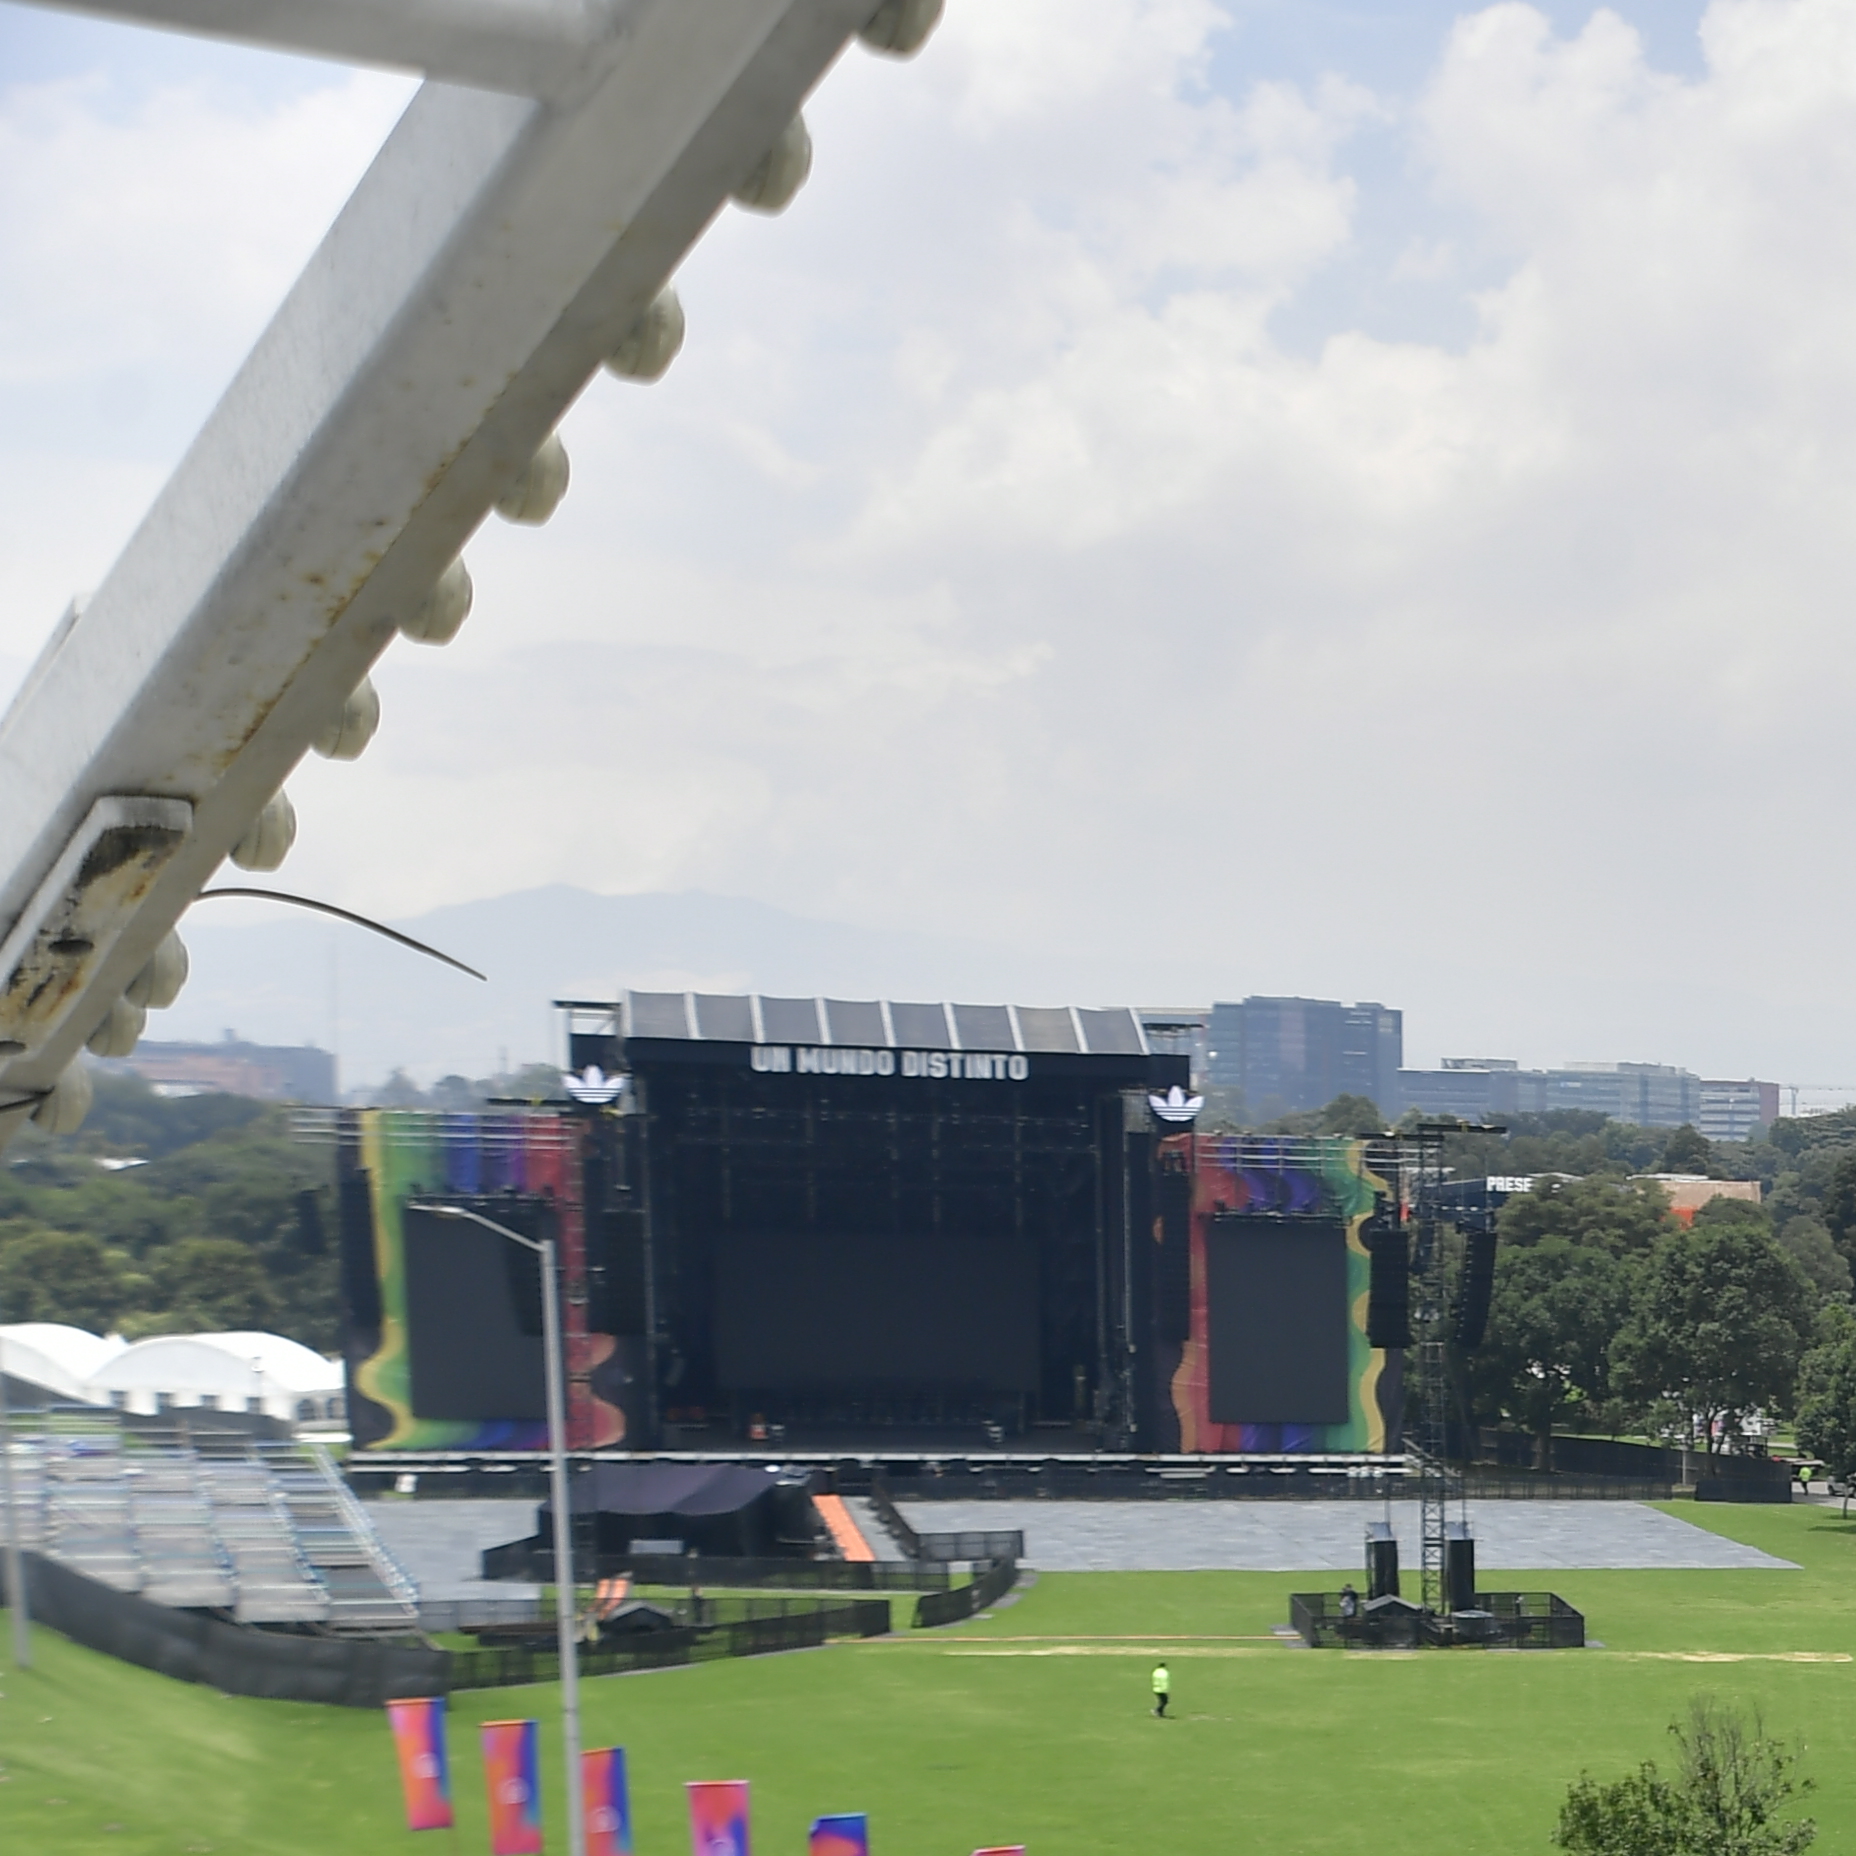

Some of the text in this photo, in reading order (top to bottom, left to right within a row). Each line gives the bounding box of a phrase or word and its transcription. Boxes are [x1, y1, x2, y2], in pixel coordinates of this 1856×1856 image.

[751, 1046, 1029, 1081] UN MUNDO DISTINTO
[1486, 1176, 1535, 1193] PRESE
